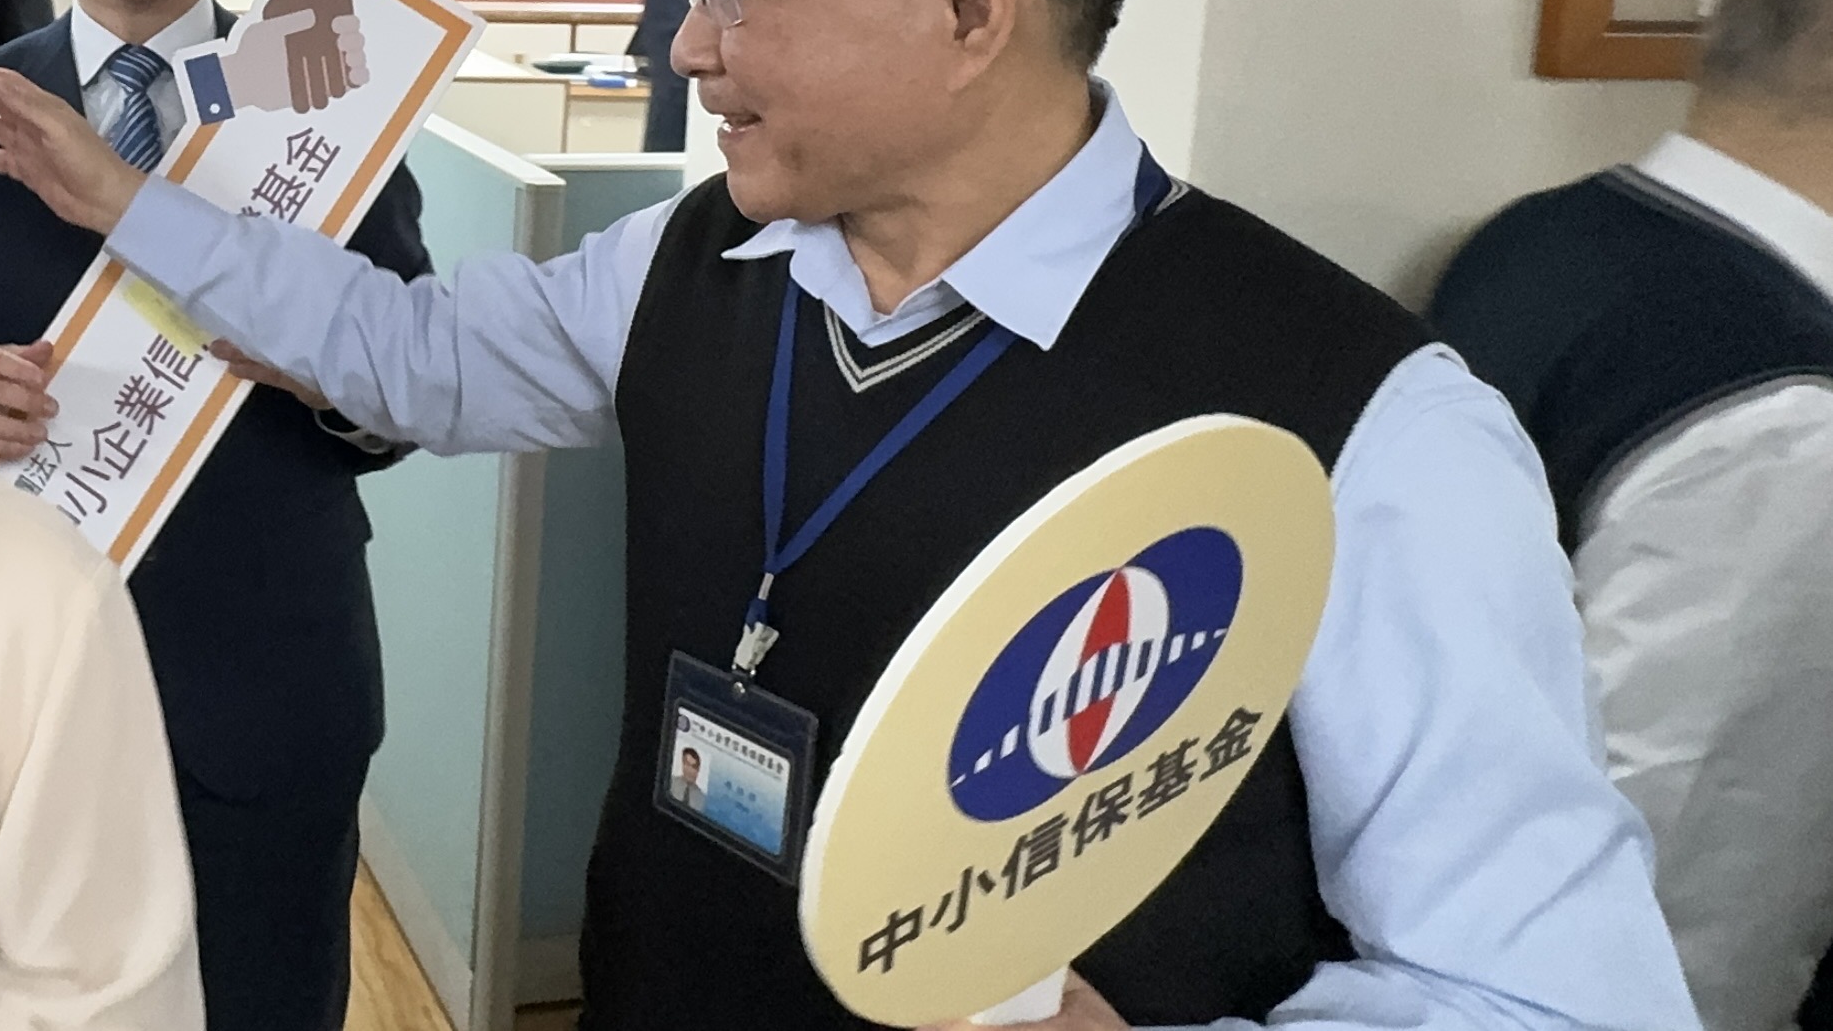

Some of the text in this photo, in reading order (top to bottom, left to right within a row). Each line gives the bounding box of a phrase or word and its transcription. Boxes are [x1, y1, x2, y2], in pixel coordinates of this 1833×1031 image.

[56, 127, 341, 525] 小企業信 基金
[856, 705, 1264, 974] 中小信保基金
